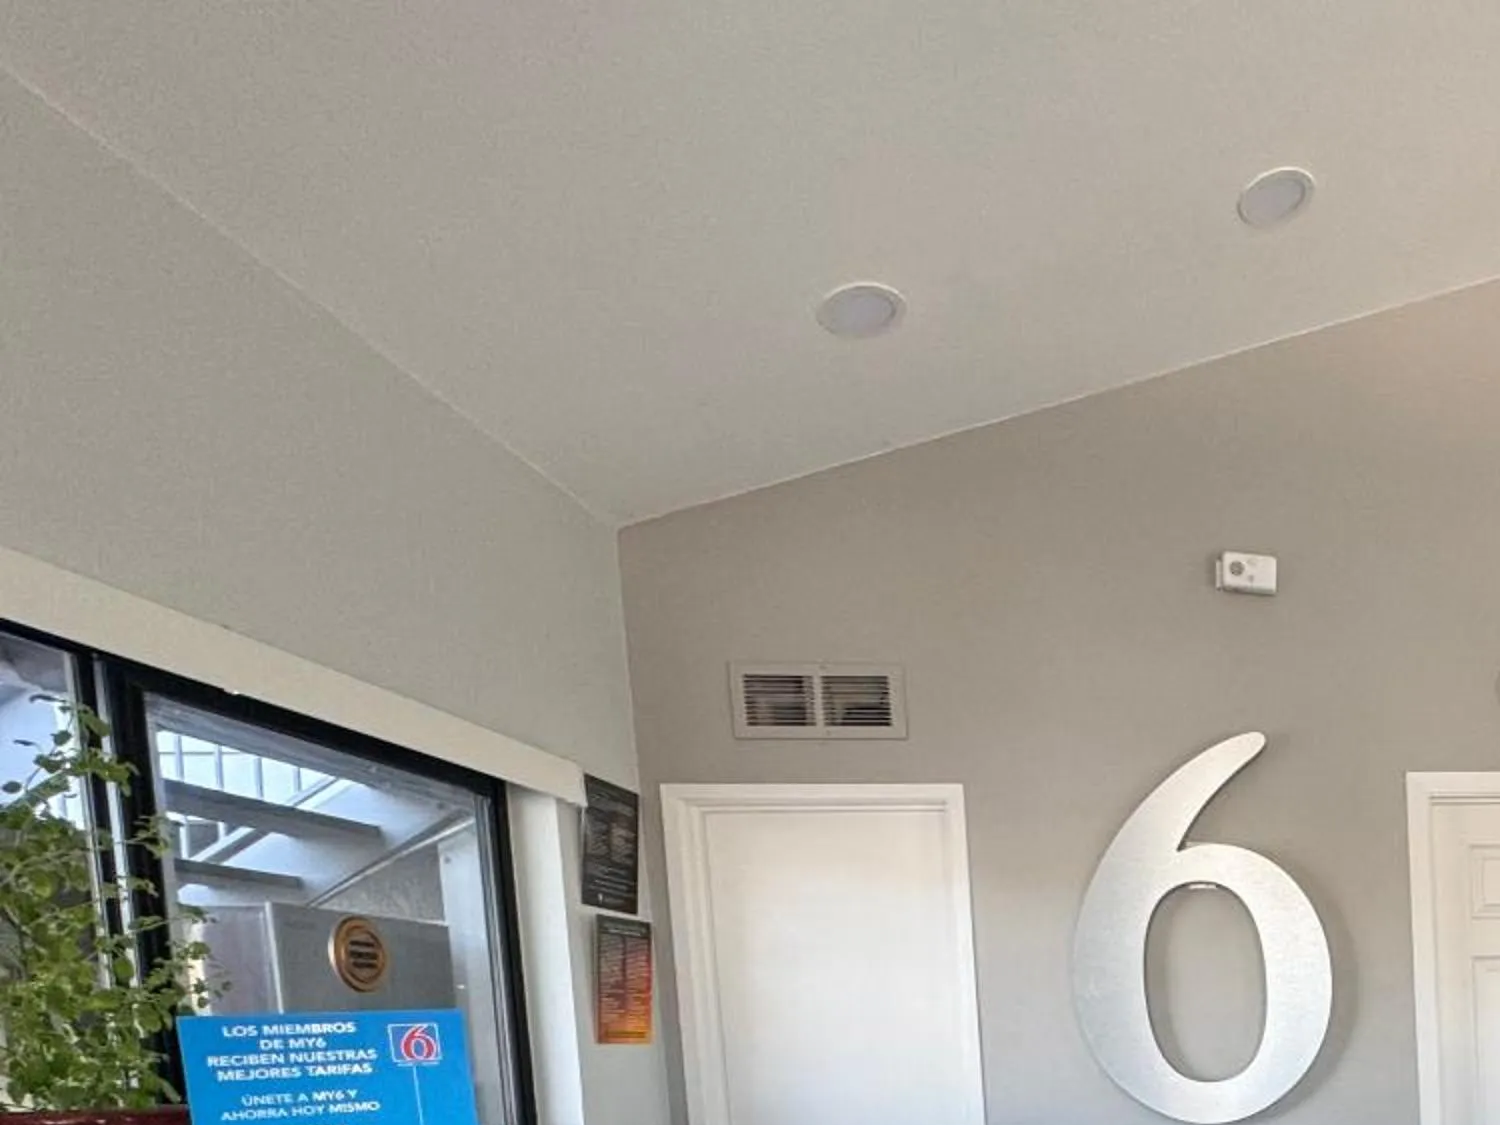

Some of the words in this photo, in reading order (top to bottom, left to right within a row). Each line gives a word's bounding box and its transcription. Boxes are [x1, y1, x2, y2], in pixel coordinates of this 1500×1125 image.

[1072, 731, 1333, 1124] 6
[222, 1026, 257, 1038] LOS
[263, 1021, 356, 1036] MIEMBROS
[260, 1039, 285, 1050] DE
[289, 1037, 327, 1049] MY6
[401, 1023, 438, 1061] 6
[207, 1053, 285, 1067] RECIBEN
[290, 1049, 378, 1064] NUESTRAS
[217, 1066, 301, 1082] MEJORES
[307, 1062, 373, 1077] TARIFAS
[241, 1090, 292, 1107] ÚNETE
[297, 1091, 309, 1103] A
[312, 1090, 345, 1102] MY6
[347, 1088, 358, 1100] Y
[221, 1109, 288, 1122] AHORRA
[292, 1105, 324, 1117] HOY
[329, 1101, 381, 1114] MISMO
